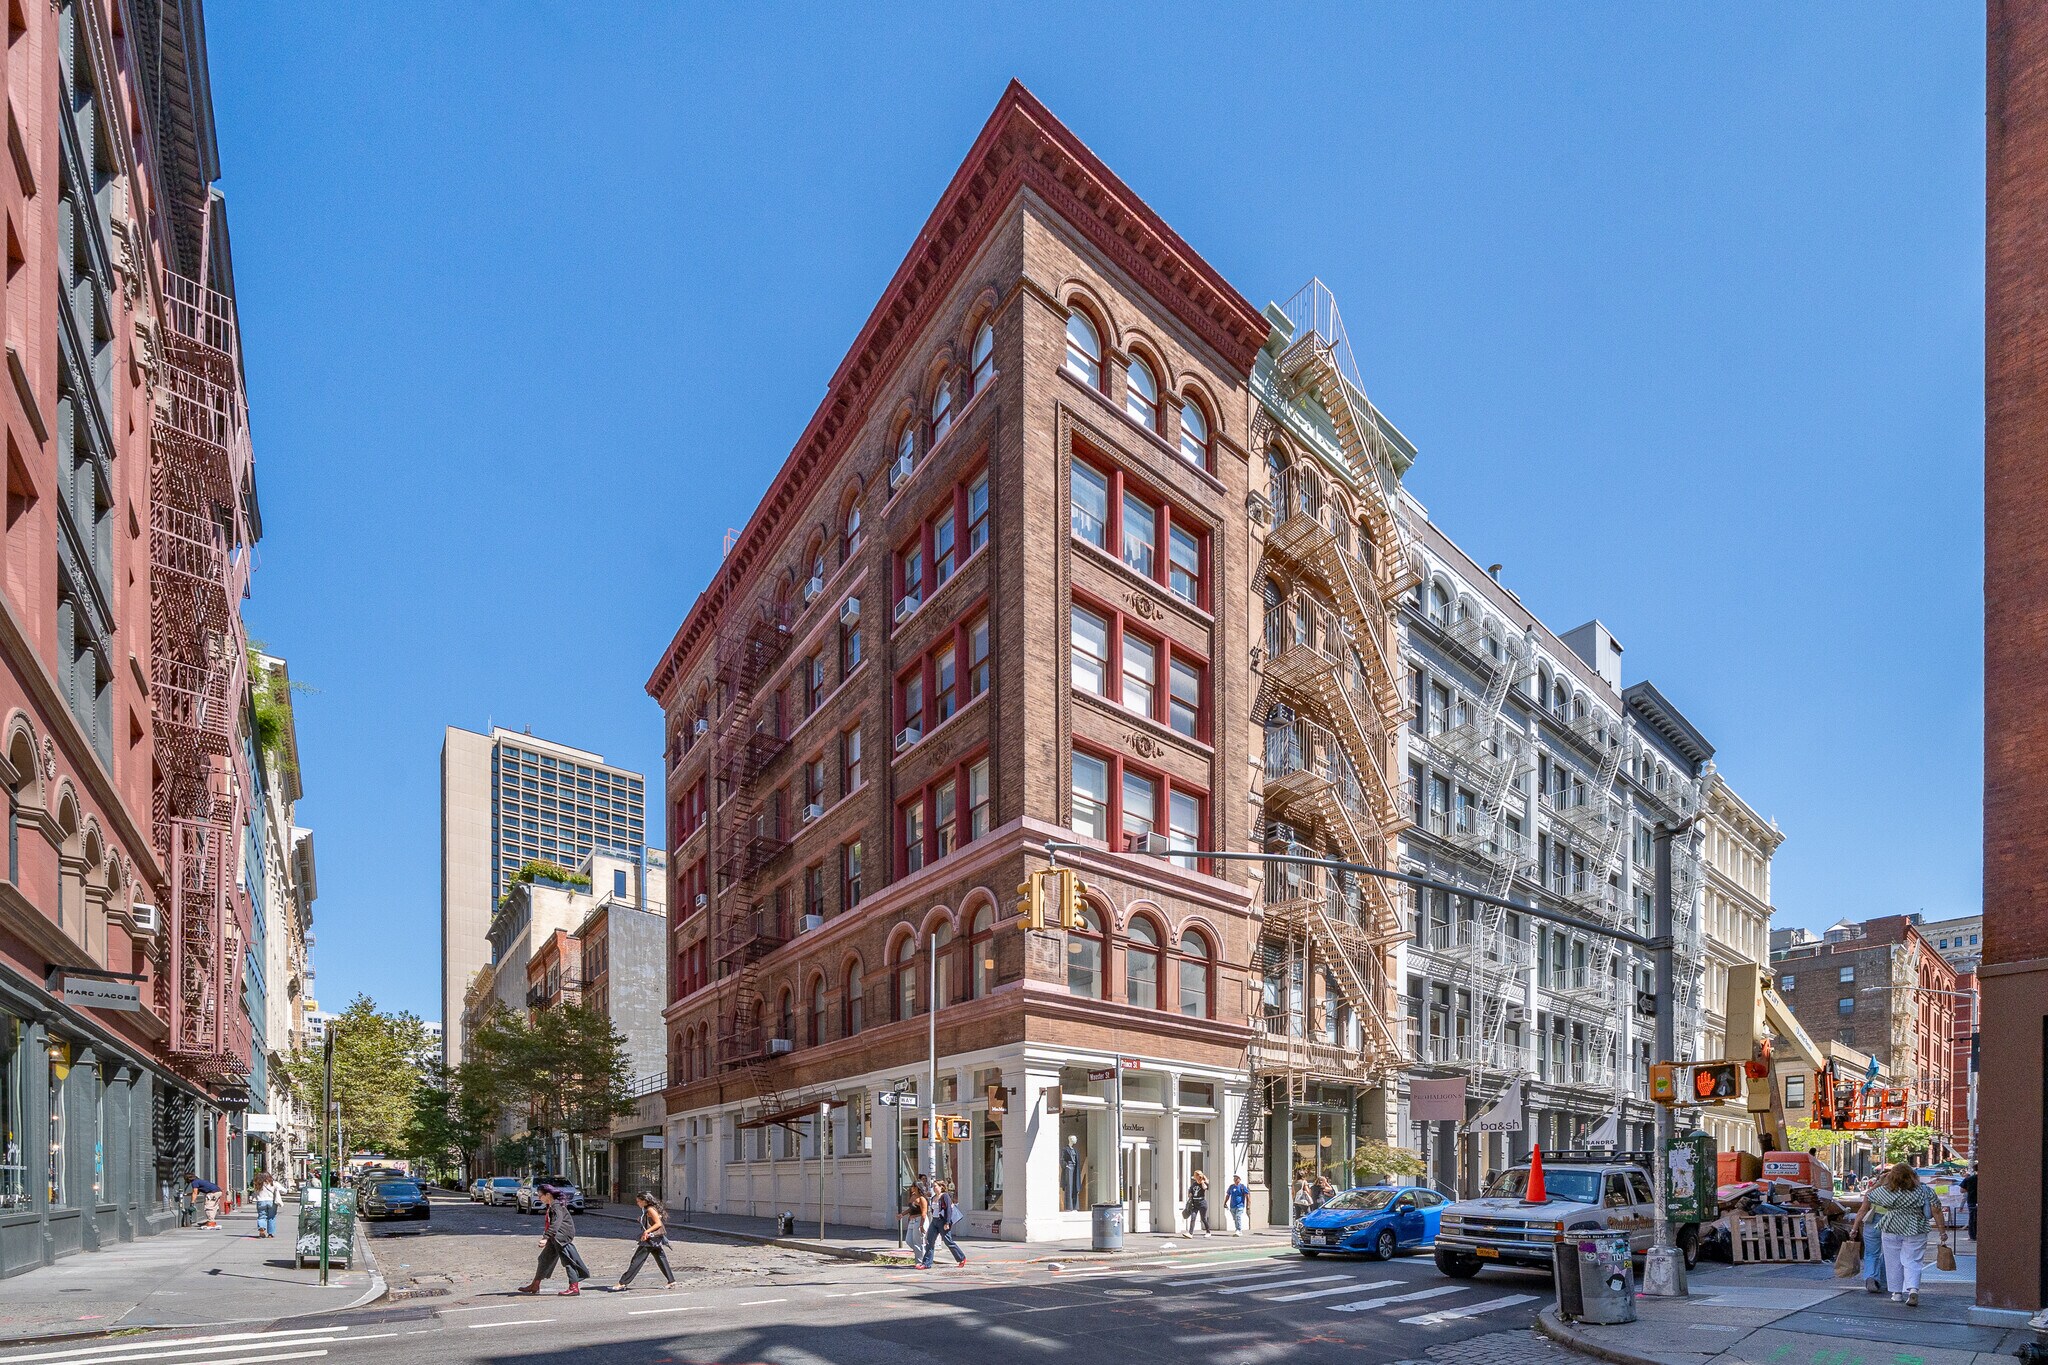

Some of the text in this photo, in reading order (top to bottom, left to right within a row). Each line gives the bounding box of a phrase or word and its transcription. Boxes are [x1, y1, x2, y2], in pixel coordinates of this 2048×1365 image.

[66, 988, 137, 1002] MARC JACOBS
[1121, 1060, 1133, 1068] Prince
[1121, 1123, 1145, 1132] MaxMara
[1480, 1119, 1520, 1131] ba&sh
